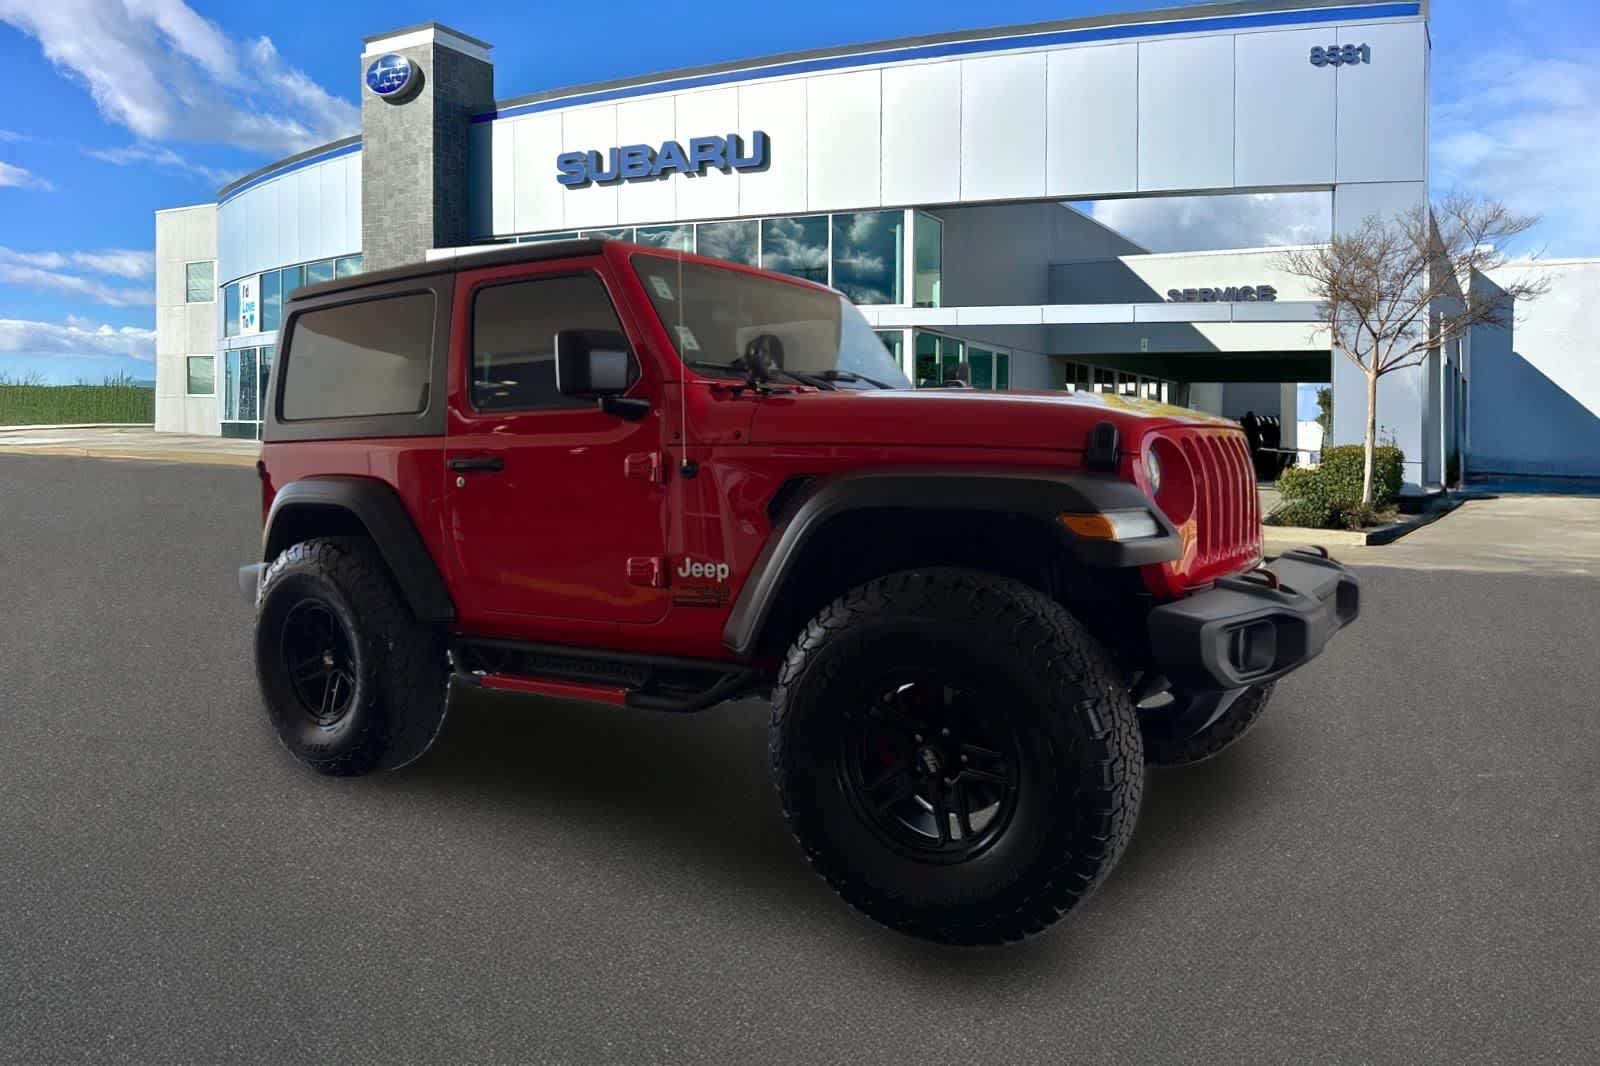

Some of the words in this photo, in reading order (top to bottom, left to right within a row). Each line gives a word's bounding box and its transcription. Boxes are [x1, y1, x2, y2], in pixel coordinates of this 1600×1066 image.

[556, 130, 770, 189] SUBARU
[1166, 285, 1277, 302] SERVICE
[677, 557, 729, 583] Jeep
